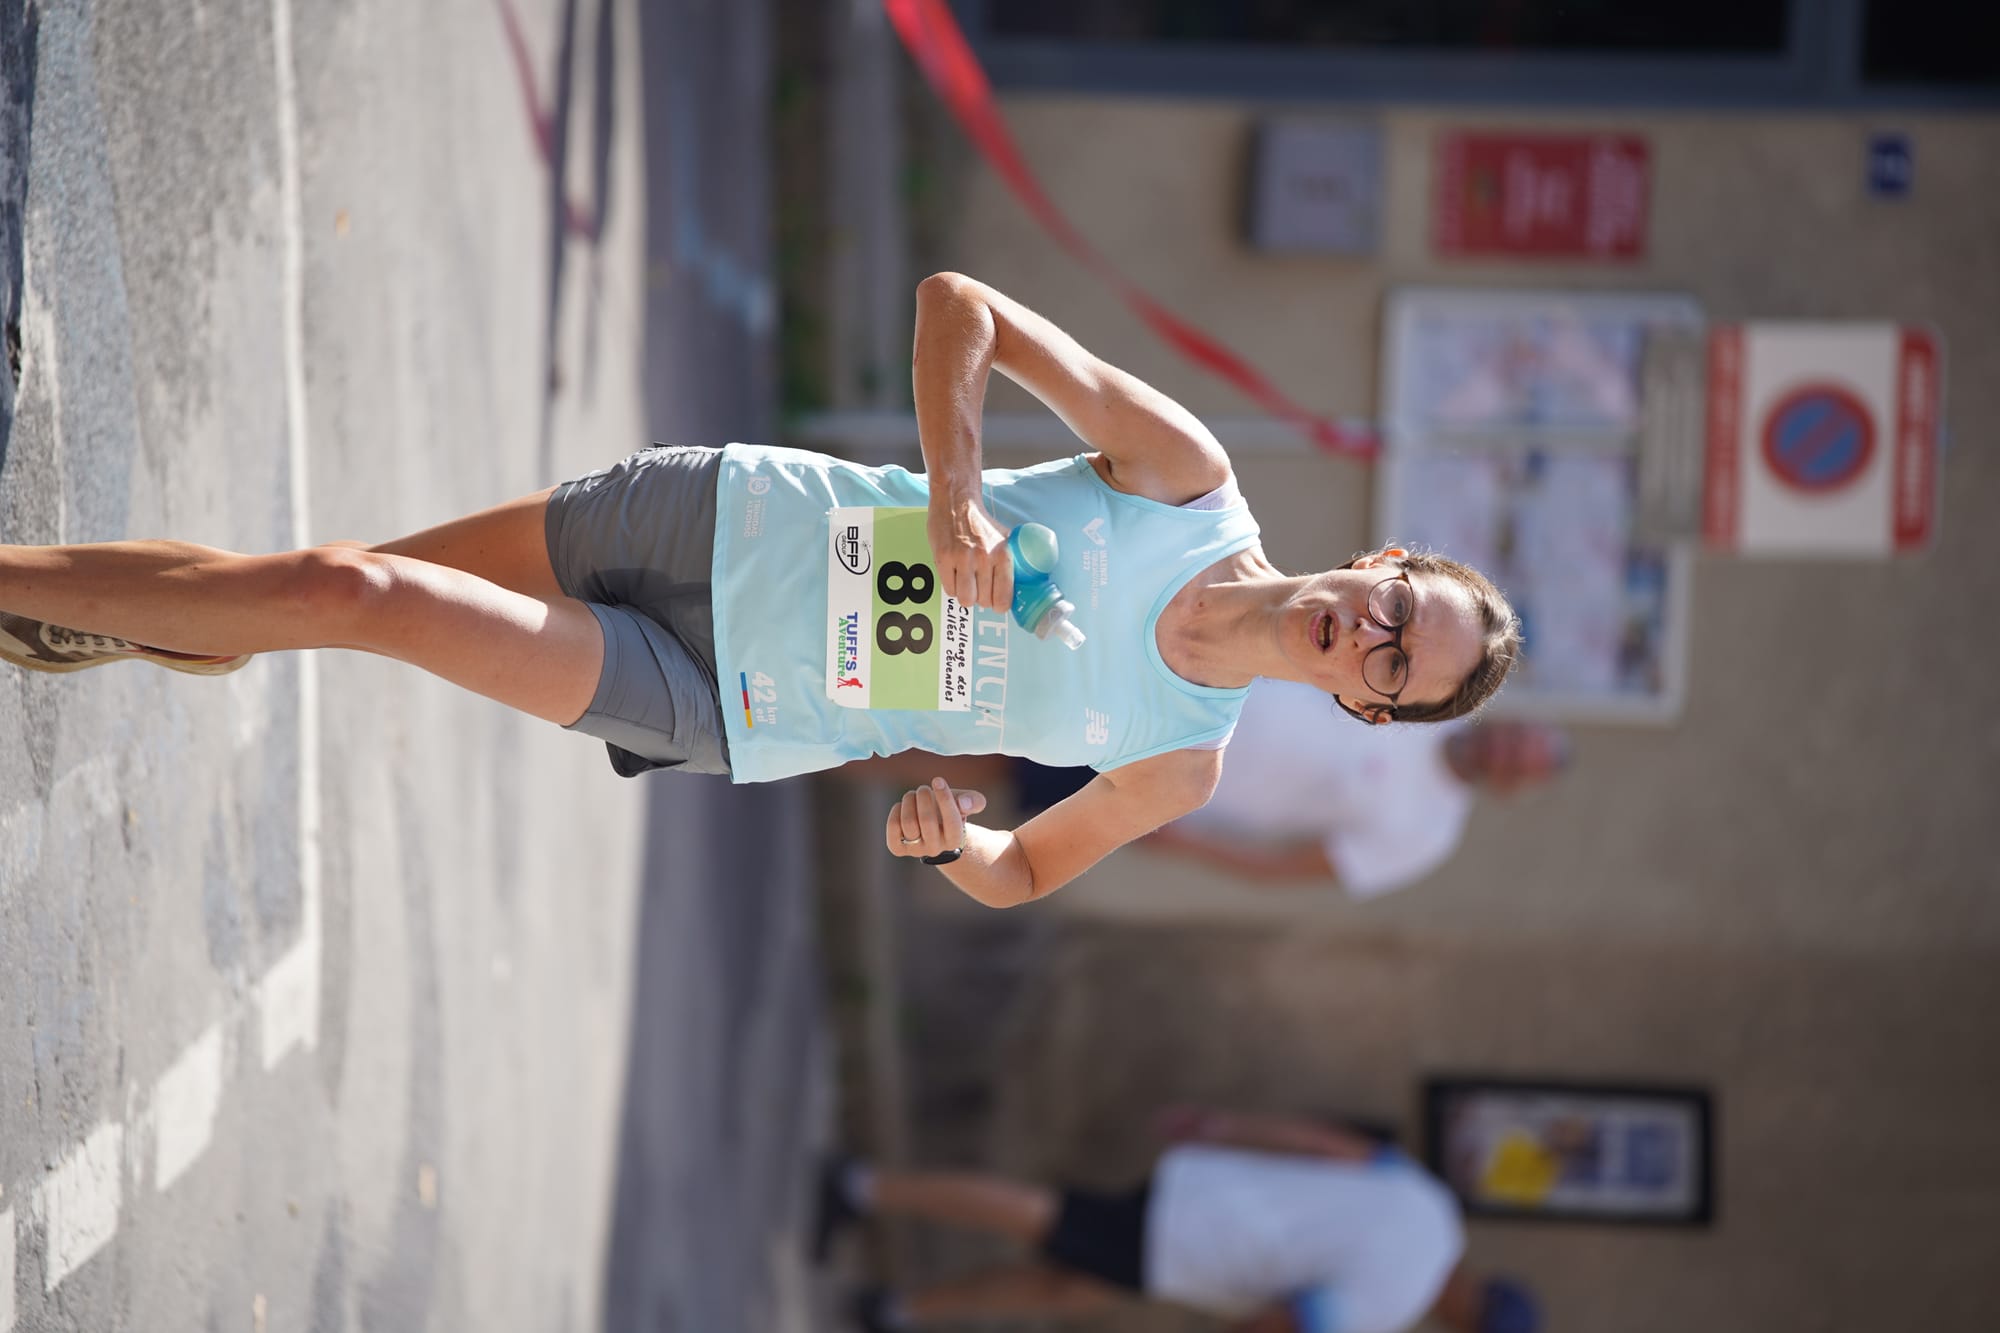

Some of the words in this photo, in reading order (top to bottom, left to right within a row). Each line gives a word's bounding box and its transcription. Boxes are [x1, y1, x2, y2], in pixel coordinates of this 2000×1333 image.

[847, 526, 859, 568] BFP
[876, 561, 934, 656] 88
[946, 598, 957, 642] vallées
[838, 617, 849, 678] Aventure
[846, 612, 858, 671] TUFF'S
[955, 606, 969, 669] Challenge
[752, 671, 777, 704] 42
[945, 649, 957, 703] cévenoles
[957, 676, 968, 697] des
[767, 706, 779, 725] km
